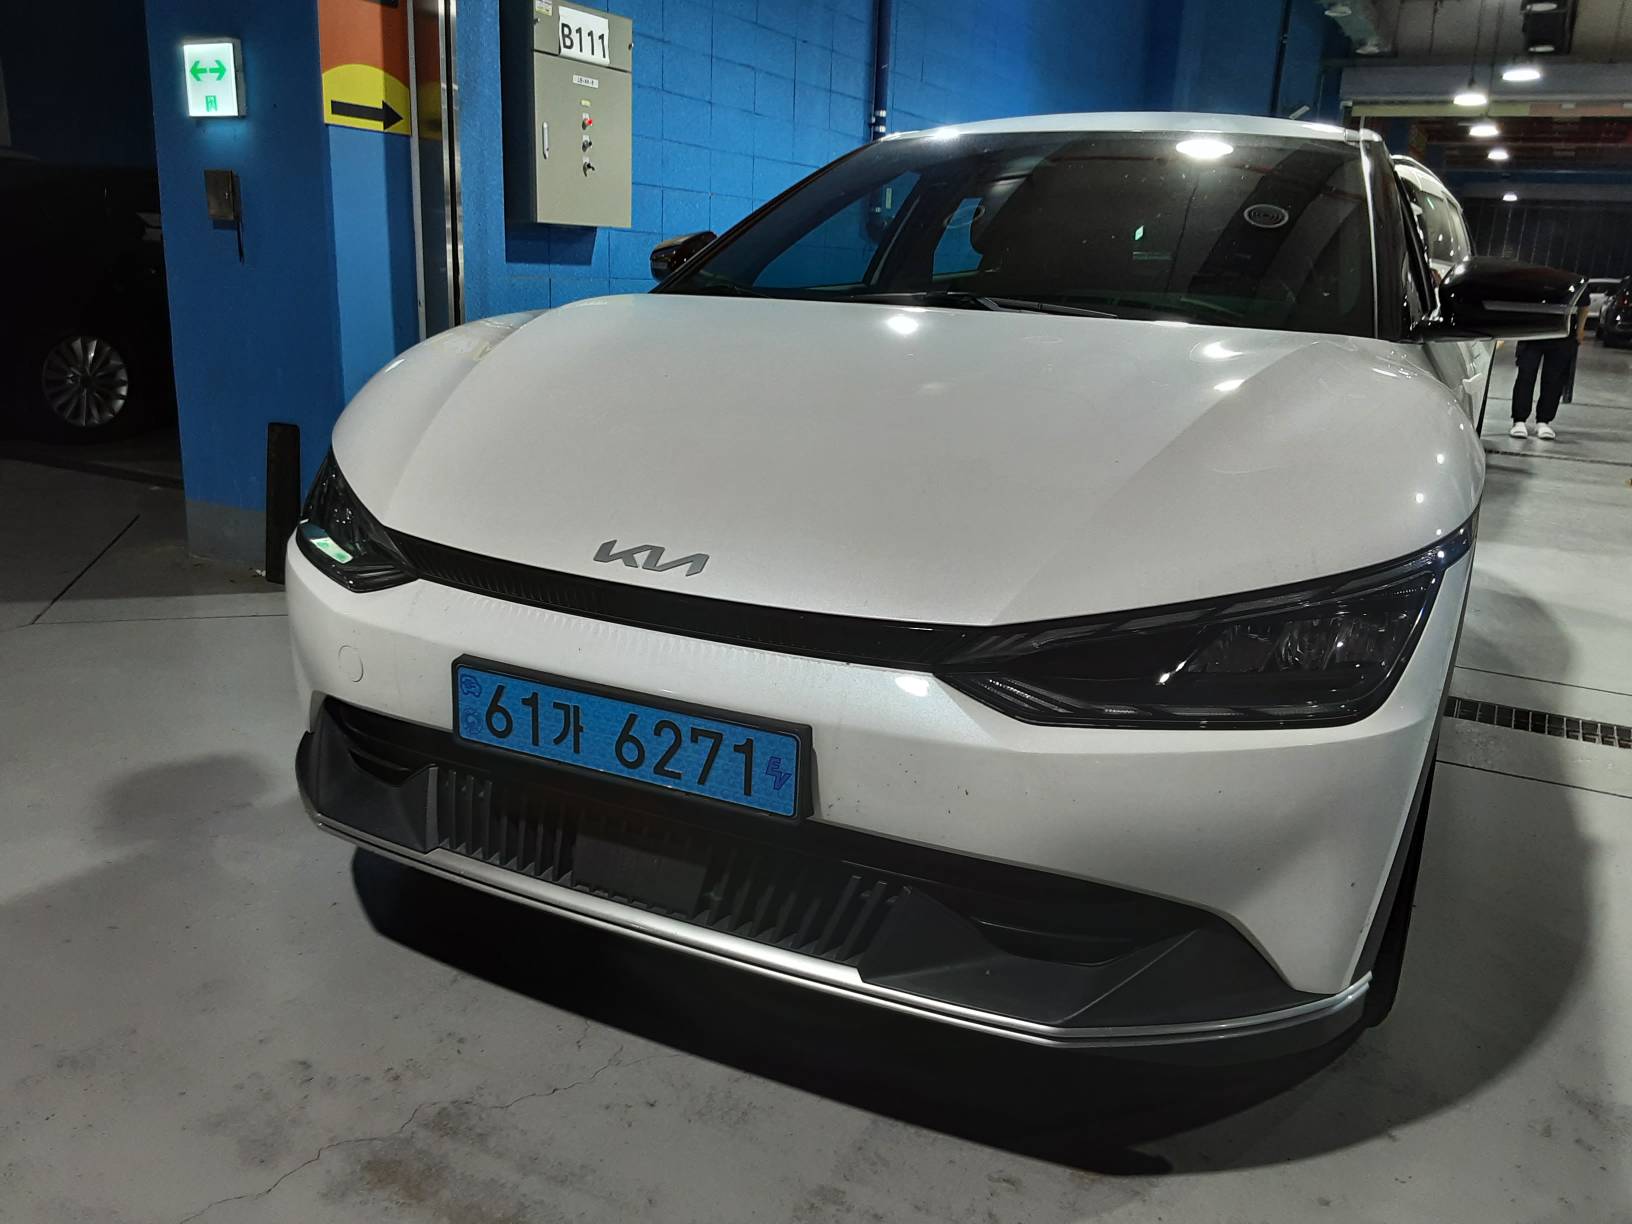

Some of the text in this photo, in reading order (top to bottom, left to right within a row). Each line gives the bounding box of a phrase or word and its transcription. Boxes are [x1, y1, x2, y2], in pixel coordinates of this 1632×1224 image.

[561, 22, 606, 59] B111
[485, 684, 754, 796] 61가 6271
